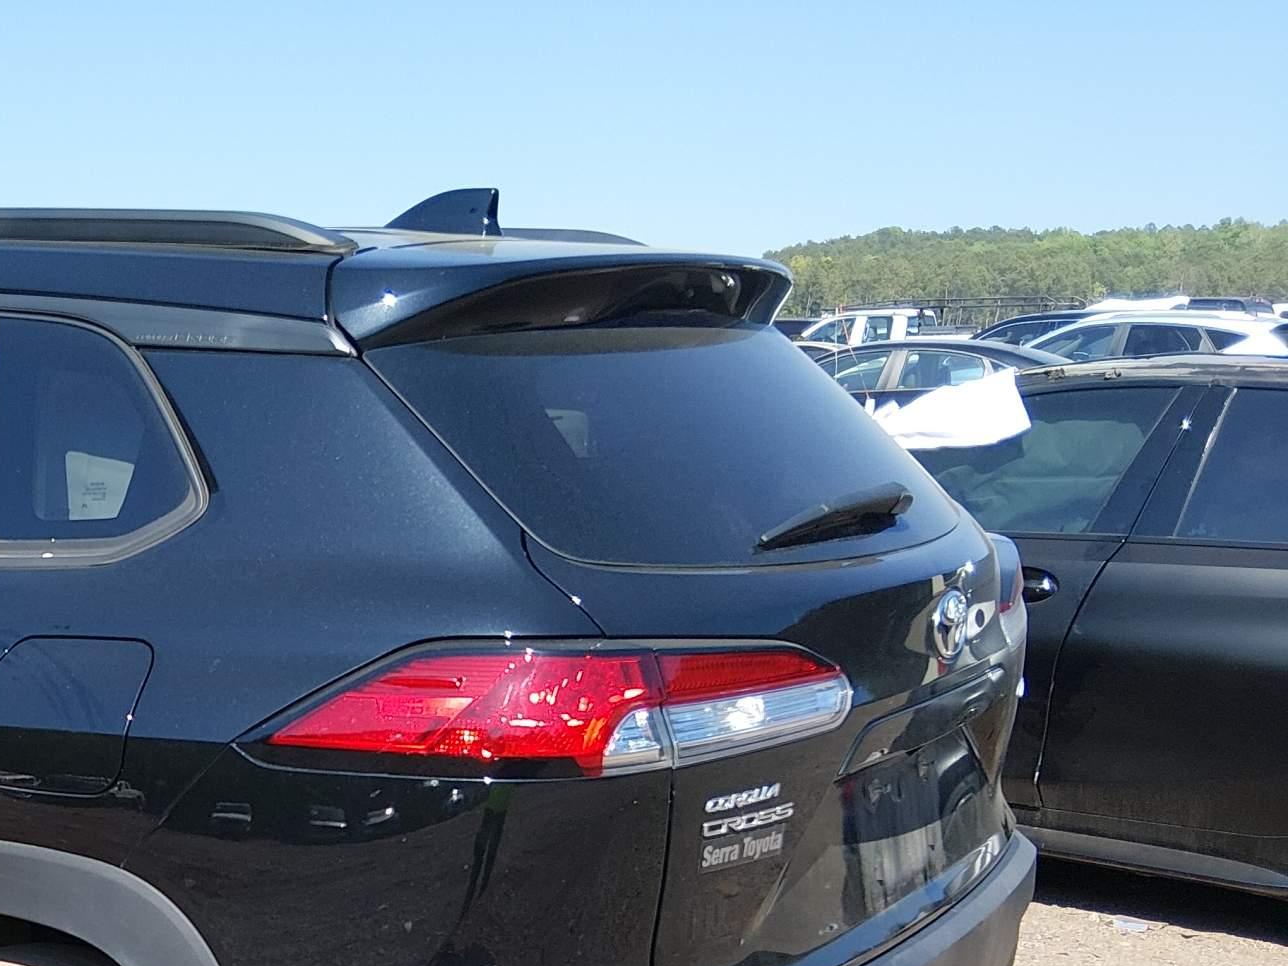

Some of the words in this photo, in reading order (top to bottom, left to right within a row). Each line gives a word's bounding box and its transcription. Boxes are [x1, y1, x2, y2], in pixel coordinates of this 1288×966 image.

[705, 783, 781, 813] COROLLA
[702, 802, 794, 837] CROSS
[701, 844, 740, 868] Serra
[742, 831, 783, 860] Toyota
